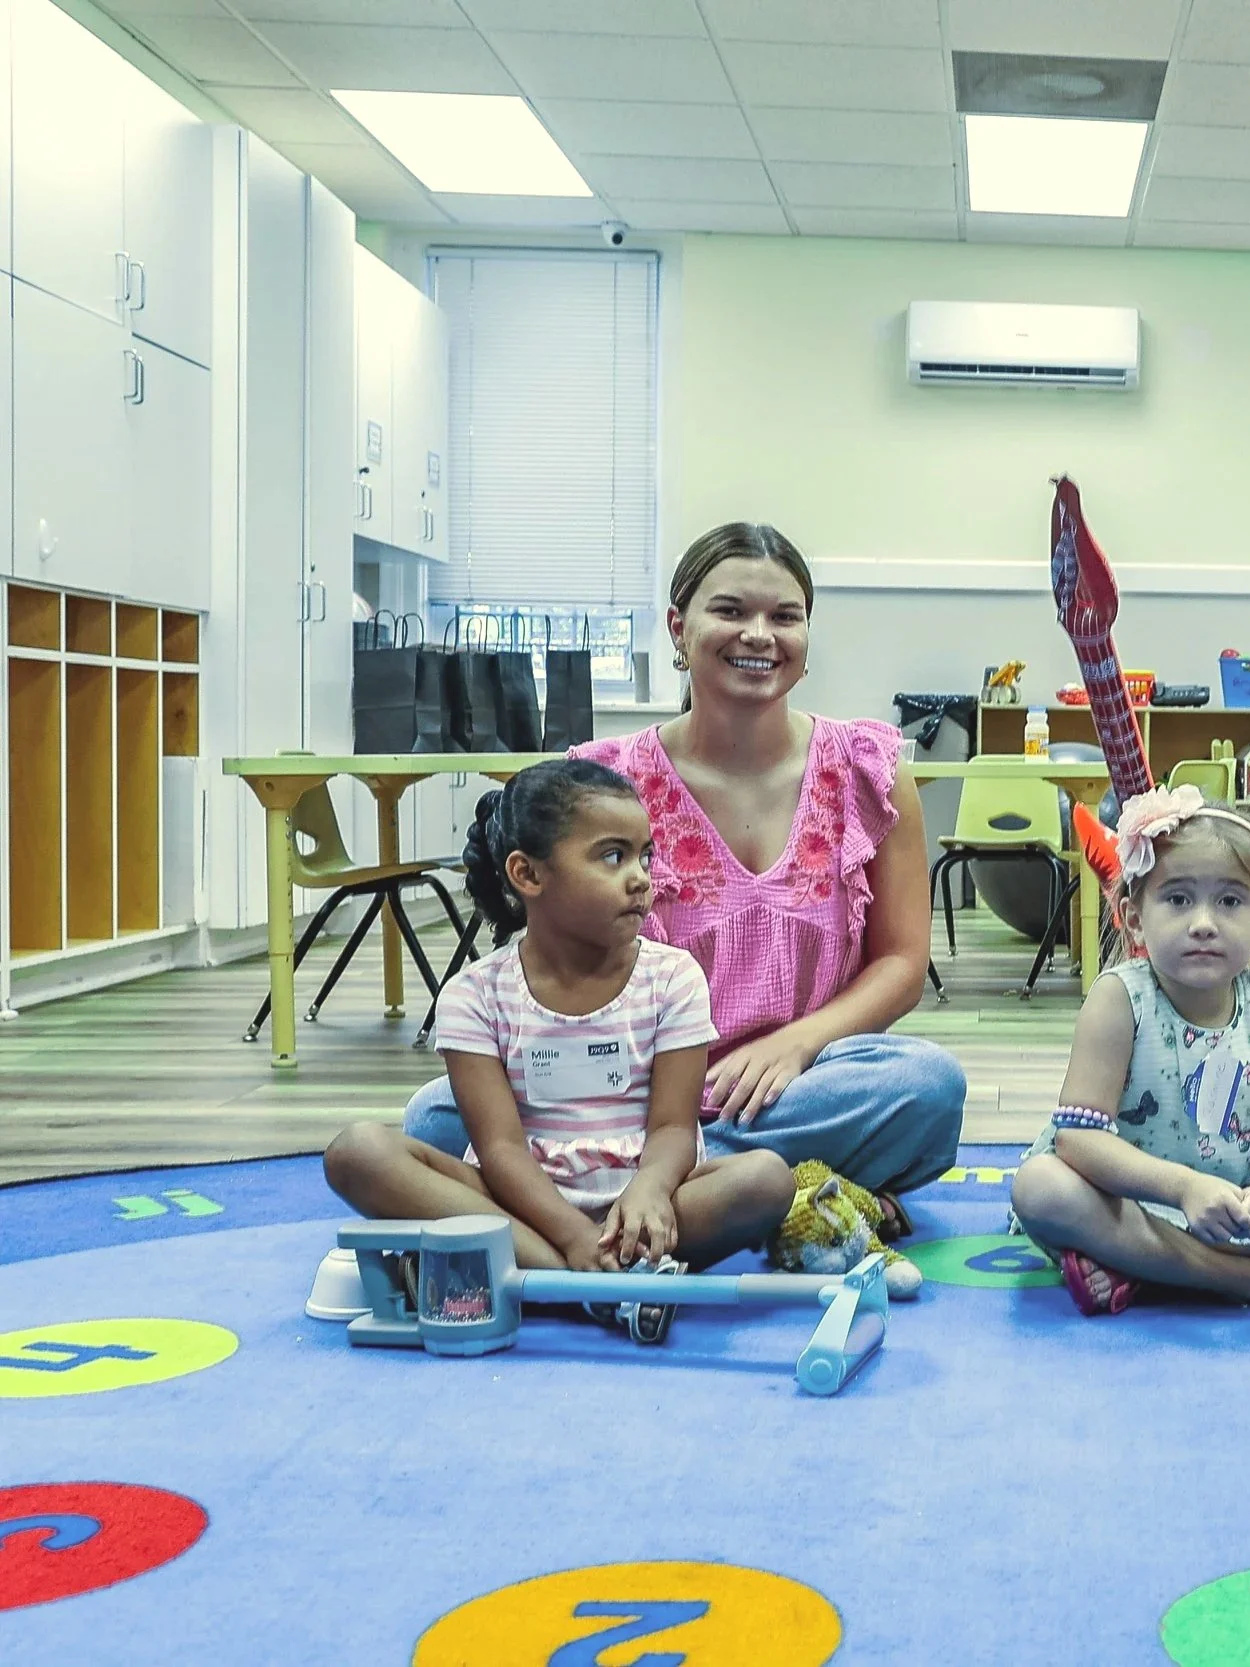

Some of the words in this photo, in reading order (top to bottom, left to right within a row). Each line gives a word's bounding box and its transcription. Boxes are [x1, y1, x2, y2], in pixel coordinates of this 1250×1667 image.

[531, 1049, 560, 1061] Millie
[964, 1245, 1047, 1273] 6
[0, 1341, 157, 1373] 4
